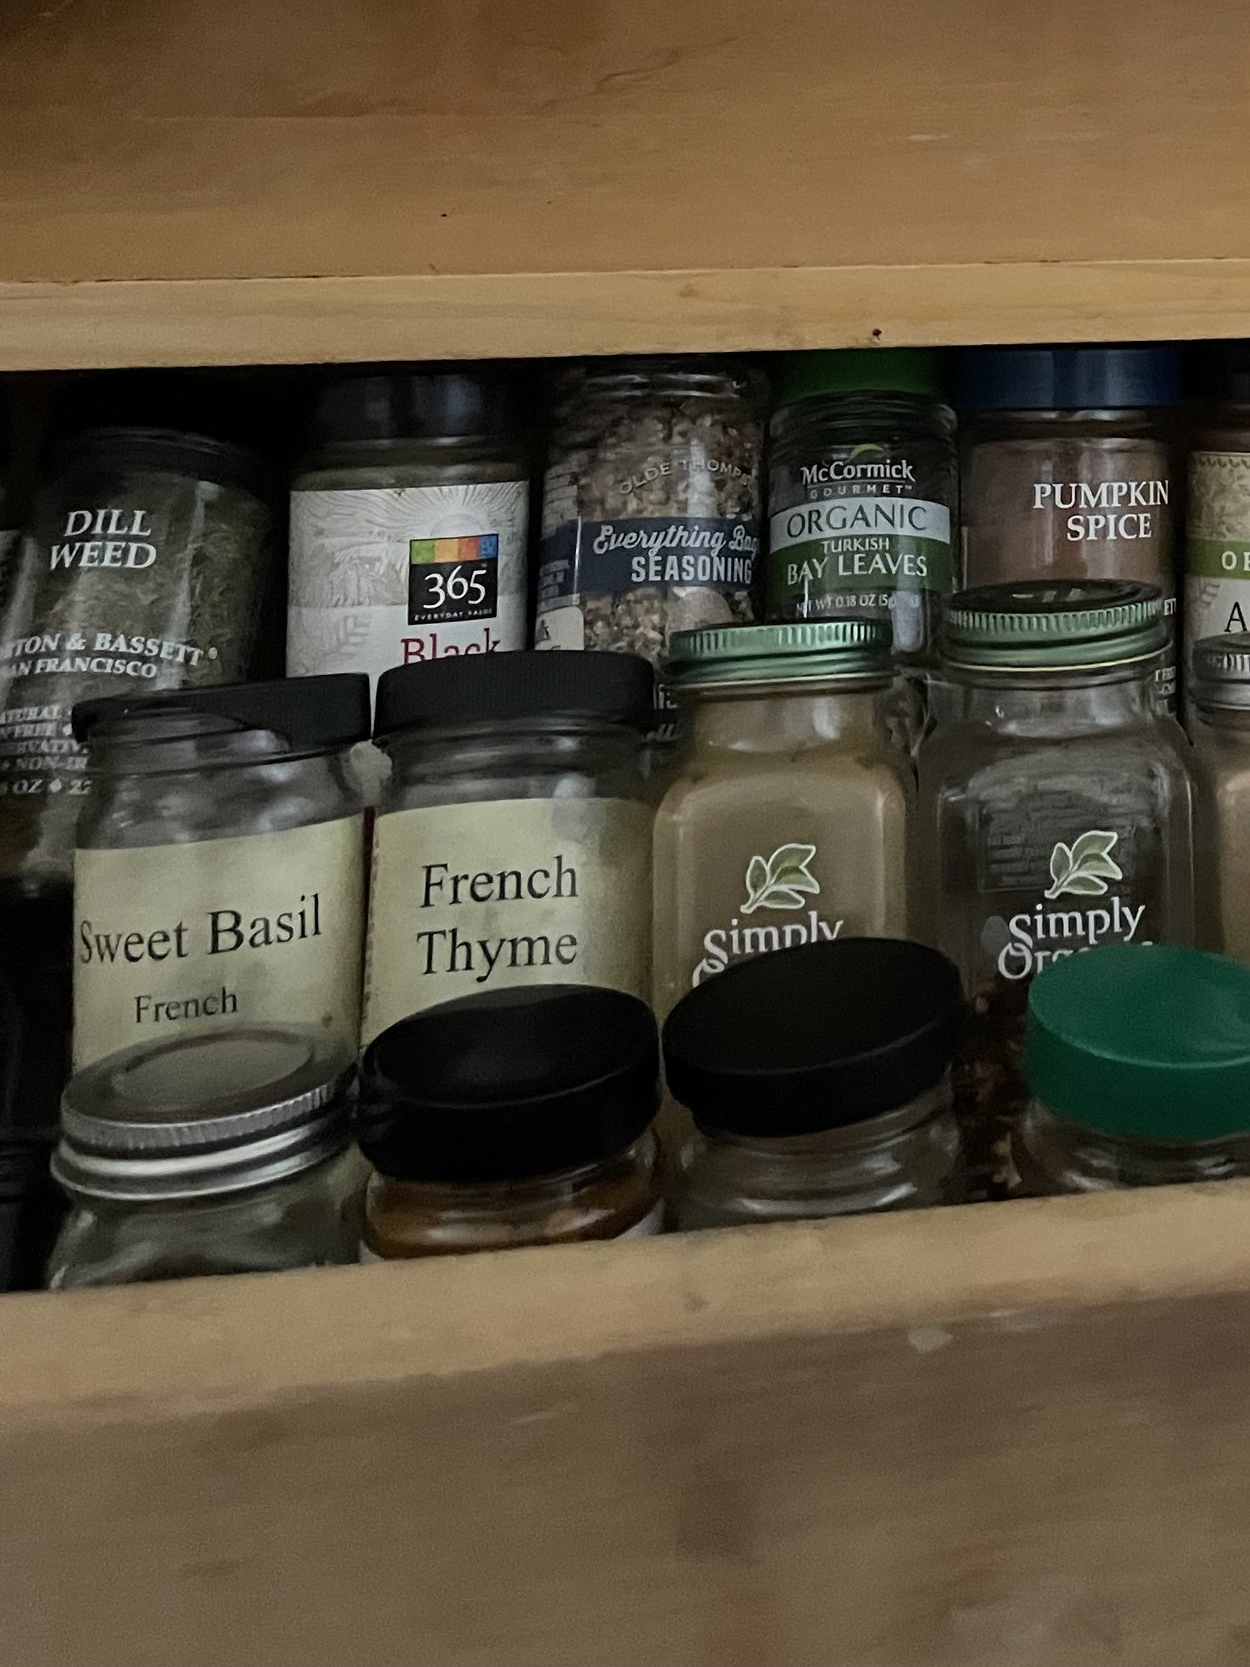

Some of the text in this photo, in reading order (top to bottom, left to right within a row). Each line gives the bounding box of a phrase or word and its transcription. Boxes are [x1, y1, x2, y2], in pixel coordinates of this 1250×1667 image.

[619, 458, 755, 495] OLDE THOMPS
[801, 459, 917, 486] McCormick
[809, 484, 903, 500] GOURMET
[1033, 479, 1170, 510] PUMPKIN
[63, 509, 152, 537] DILL
[787, 503, 927, 538] ORGANIC
[1066, 513, 1152, 542] SPICE
[50, 541, 157, 570] WEED
[592, 524, 760, 561] Everything Bag
[822, 537, 890, 555] TURKISH
[631, 555, 752, 585] SEASONING
[787, 553, 928, 586] BAY LEAVES
[423, 565, 487, 610] 365
[859, 593, 876, 607] OZ
[414, 609, 465, 622] EVERYDAY
[0, 633, 204, 666] TON & BASSETT
[35, 657, 158, 678] FRANCISCO
[13, 779, 43, 794] OZ
[420, 854, 579, 909] French
[80, 893, 322, 965] Sweet Basil
[703, 910, 844, 965] Simply
[1008, 897, 1147, 950] Simply
[417, 928, 579, 984] Thyme
[134, 987, 238, 1025] French
